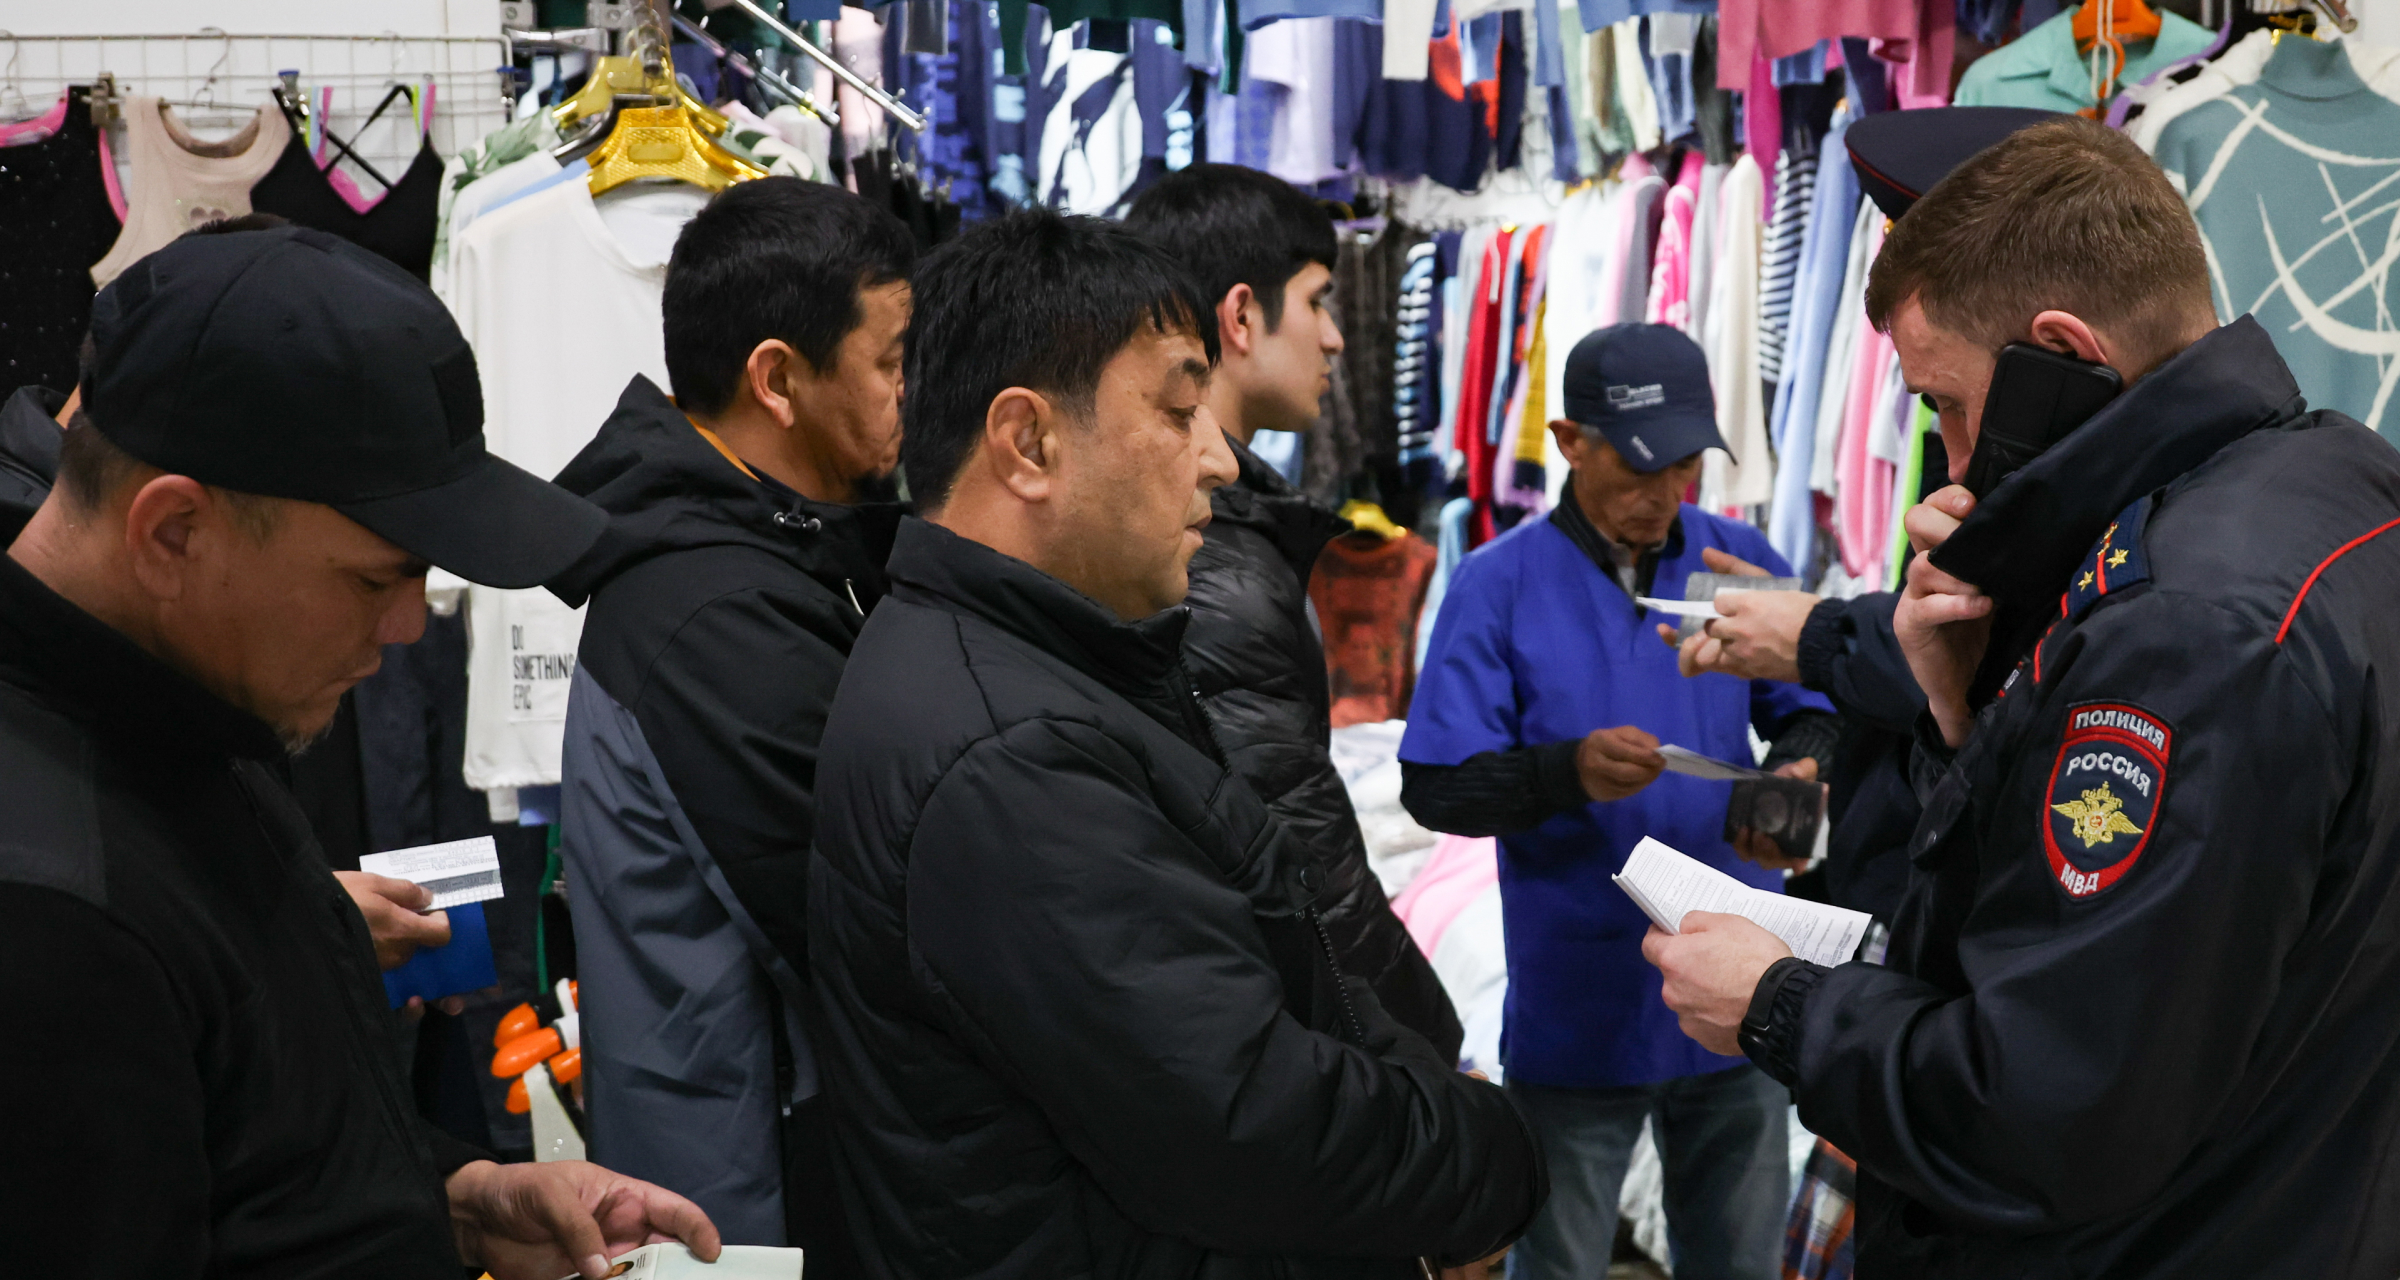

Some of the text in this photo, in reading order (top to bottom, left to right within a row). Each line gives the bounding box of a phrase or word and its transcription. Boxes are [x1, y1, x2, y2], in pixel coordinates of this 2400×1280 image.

[2074, 709, 2166, 751] ПОЛИЦИЯ
[2066, 752, 2152, 798] РОССИЯ
[2060, 863, 2100, 895] МВД
